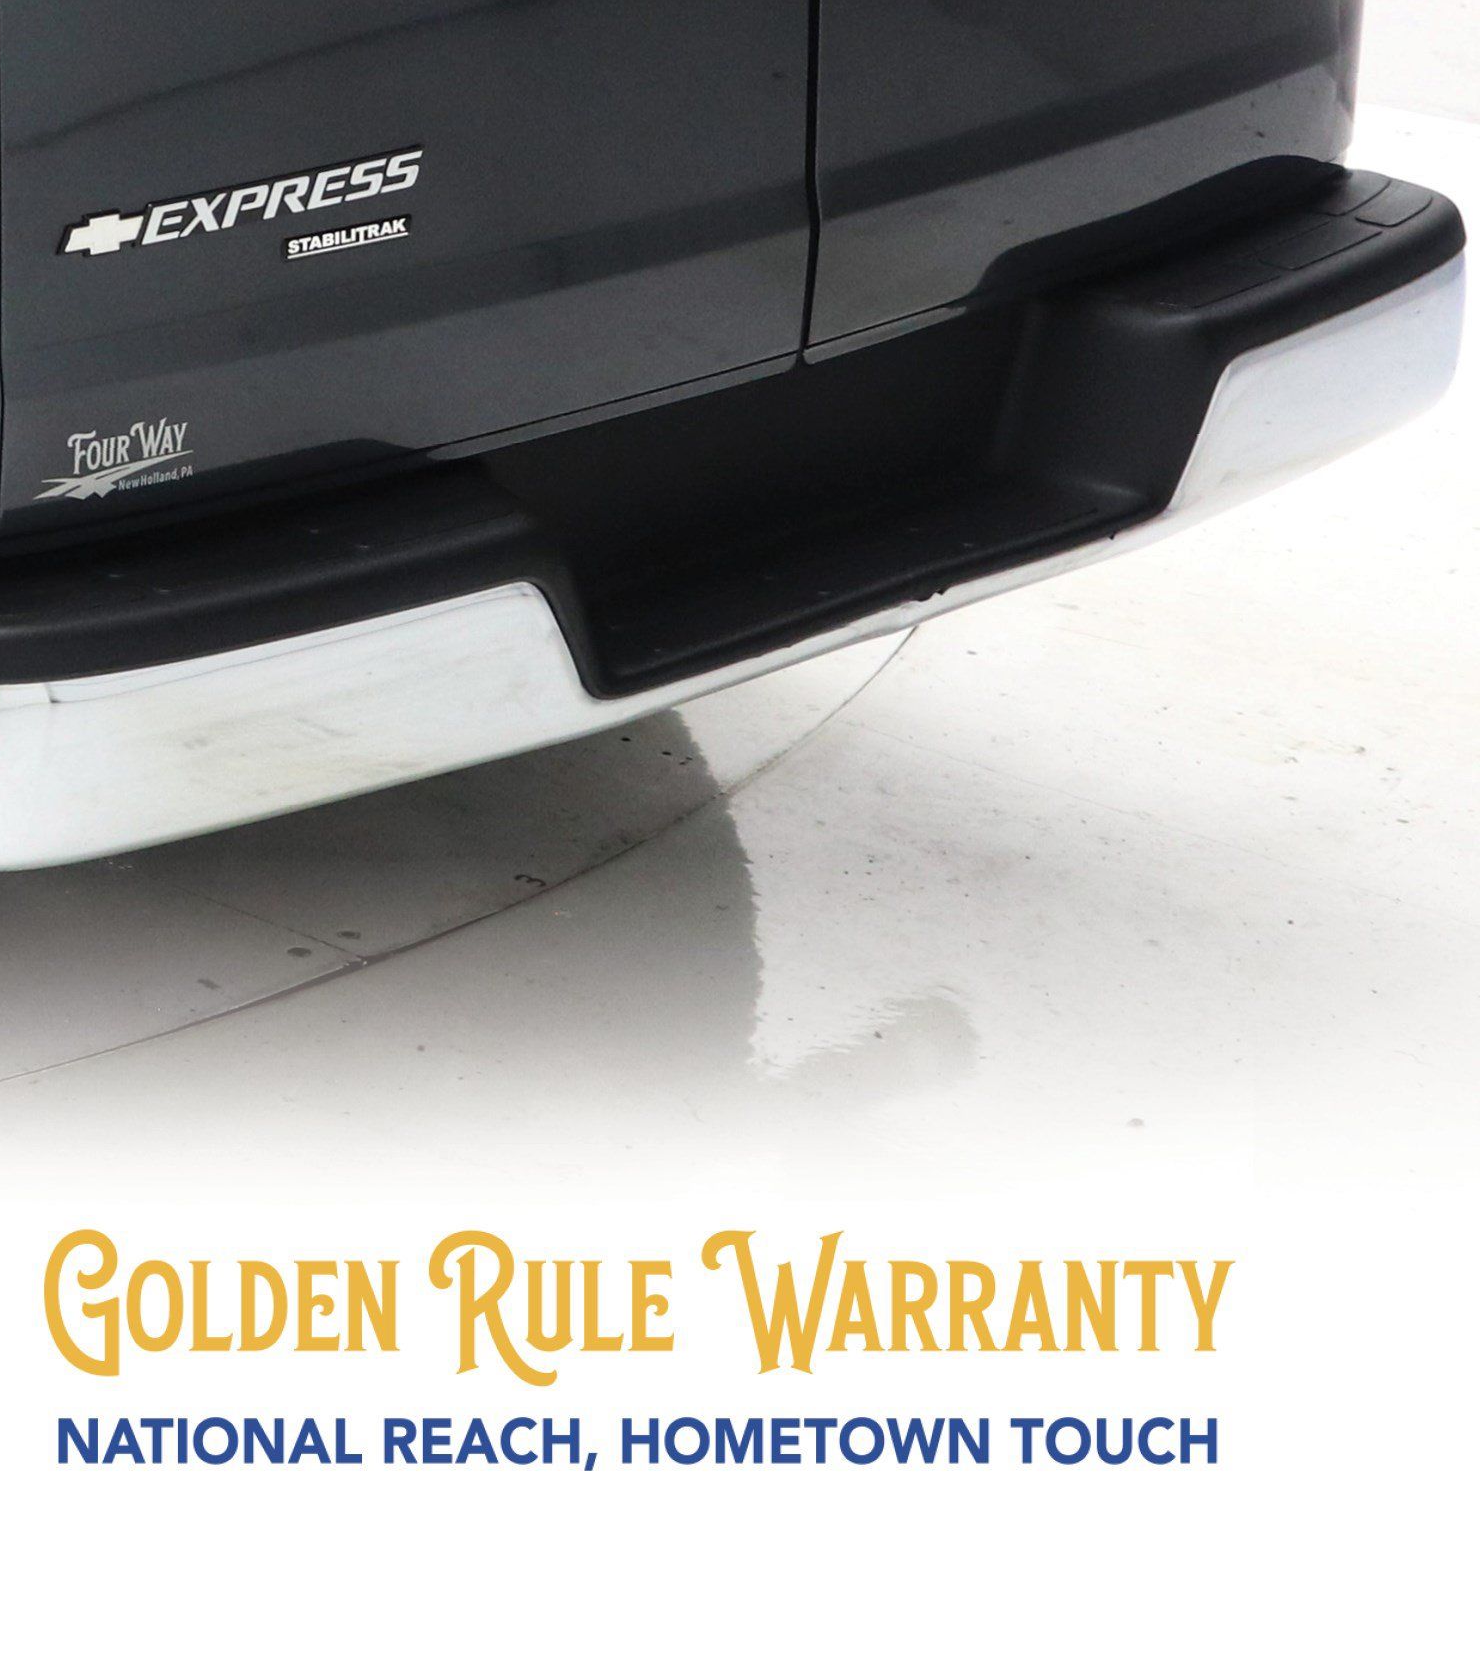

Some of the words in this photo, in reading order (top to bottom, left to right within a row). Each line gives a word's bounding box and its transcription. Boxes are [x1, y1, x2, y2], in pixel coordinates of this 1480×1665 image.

[141, 149, 424, 246] EXPRESS
[287, 217, 408, 256] STABILITRAK
[118, 480, 139, 491] New
[140, 468, 180, 486] Holland,
[181, 465, 194, 477] PA
